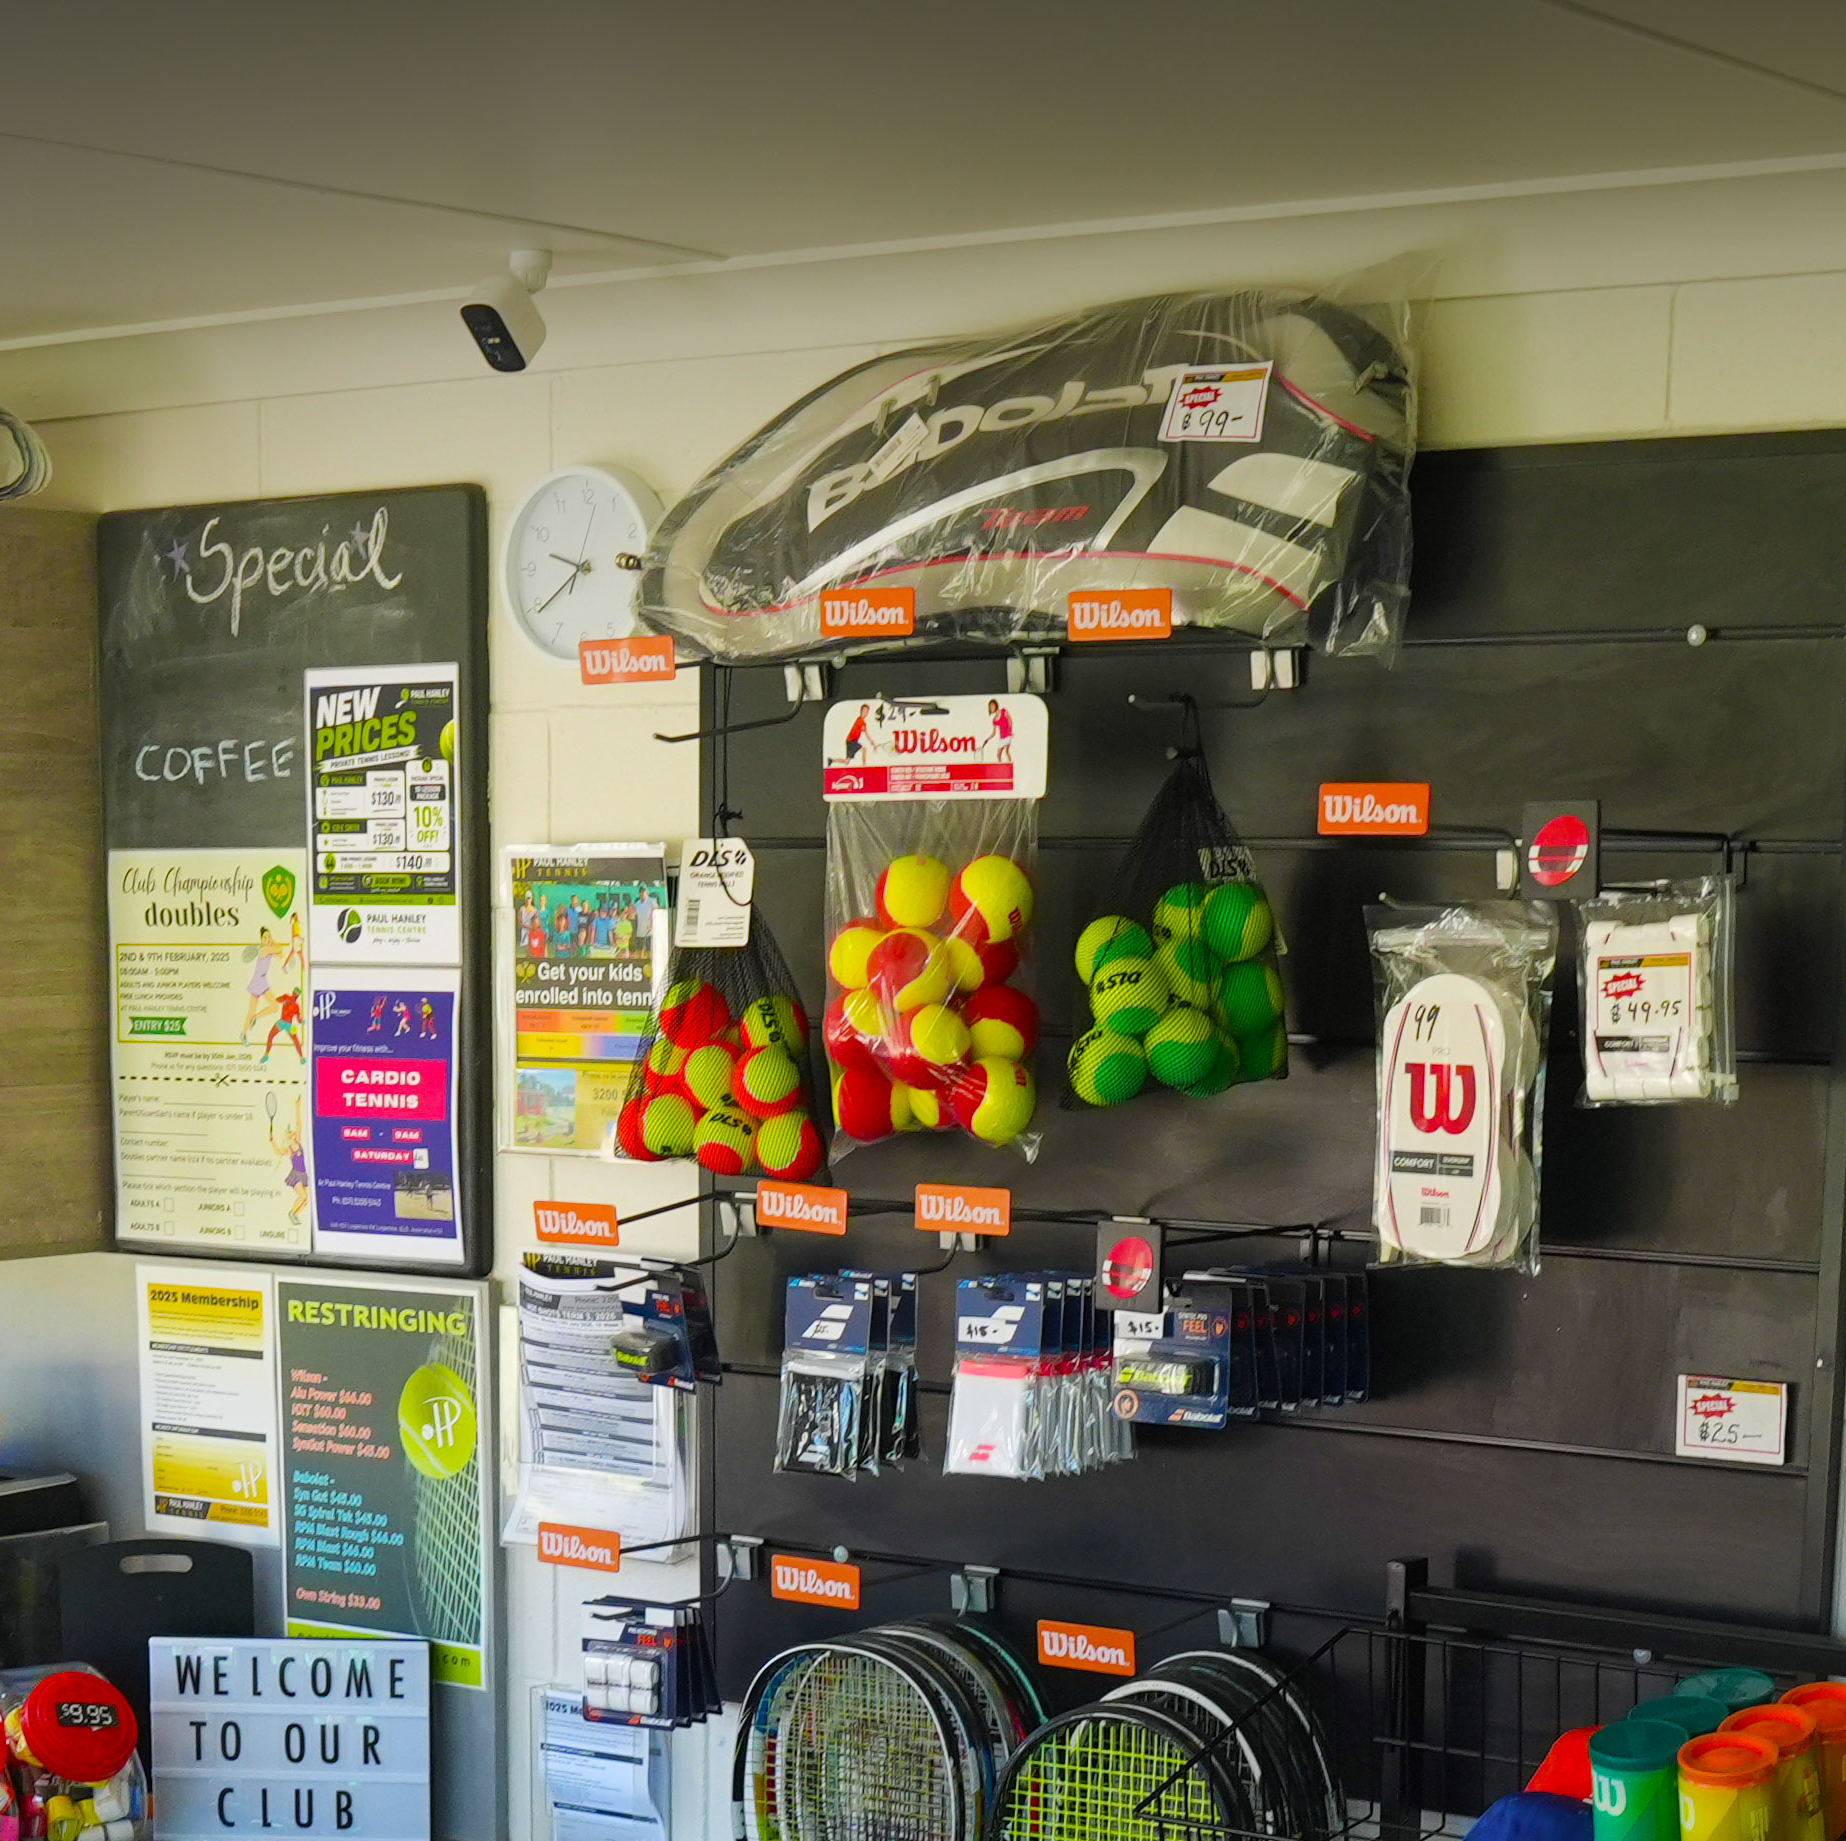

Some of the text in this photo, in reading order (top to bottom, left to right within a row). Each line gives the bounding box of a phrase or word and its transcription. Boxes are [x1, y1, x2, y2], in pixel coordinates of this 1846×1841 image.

[186, 506, 403, 637] Special
[824, 598, 911, 629] Wilson
[1072, 600, 1165, 631] Wilson
[583, 649, 667, 675] Wilson
[316, 686, 382, 729] NEW
[316, 711, 417, 761] PRICES
[892, 729, 977, 754] Wilson
[135, 736, 296, 785] COFFEE
[413, 805, 443, 828] 10%
[1322, 794, 1418, 825] Wilson
[417, 830, 439, 843] OFF!
[122, 866, 254, 903] Club Championship
[145, 902, 239, 928] doubles
[367, 914, 427, 925] PAUL HANLEY
[367, 924, 427, 935] TENNIS CENTRE
[537, 961, 643, 983] Get your kids
[515, 986, 613, 1006] enrolled into
[1606, 978, 1639, 995] SPECIAL
[134, 1020, 162, 1031] ENTRY
[341, 1069, 421, 1086] CARDIO
[343, 1092, 419, 1109] TENNIS
[354, 1150, 410, 1161] SATURDAY
[1394, 1155, 1434, 1171] COMFORT
[1420, 1186, 1450, 1199] Wilson
[760, 1187, 840, 1226] Wilson
[919, 1194, 1003, 1227] Wilson
[536, 1208, 612, 1238] Wilson
[150, 1290, 259, 1310] 2025 Membership
[287, 1299, 467, 1336] RESTRINGING
[1182, 1320, 1207, 1333] FEEL
[541, 1532, 613, 1565] Wilson
[775, 1564, 853, 1600] Wilson
[1041, 1630, 1128, 1668] Wilson
[176, 1655, 405, 1698] WELCOME
[61, 1704, 113, 1725] $9.95
[190, 1721, 381, 1764] TO OUR
[217, 1788, 354, 1830] CLUB
